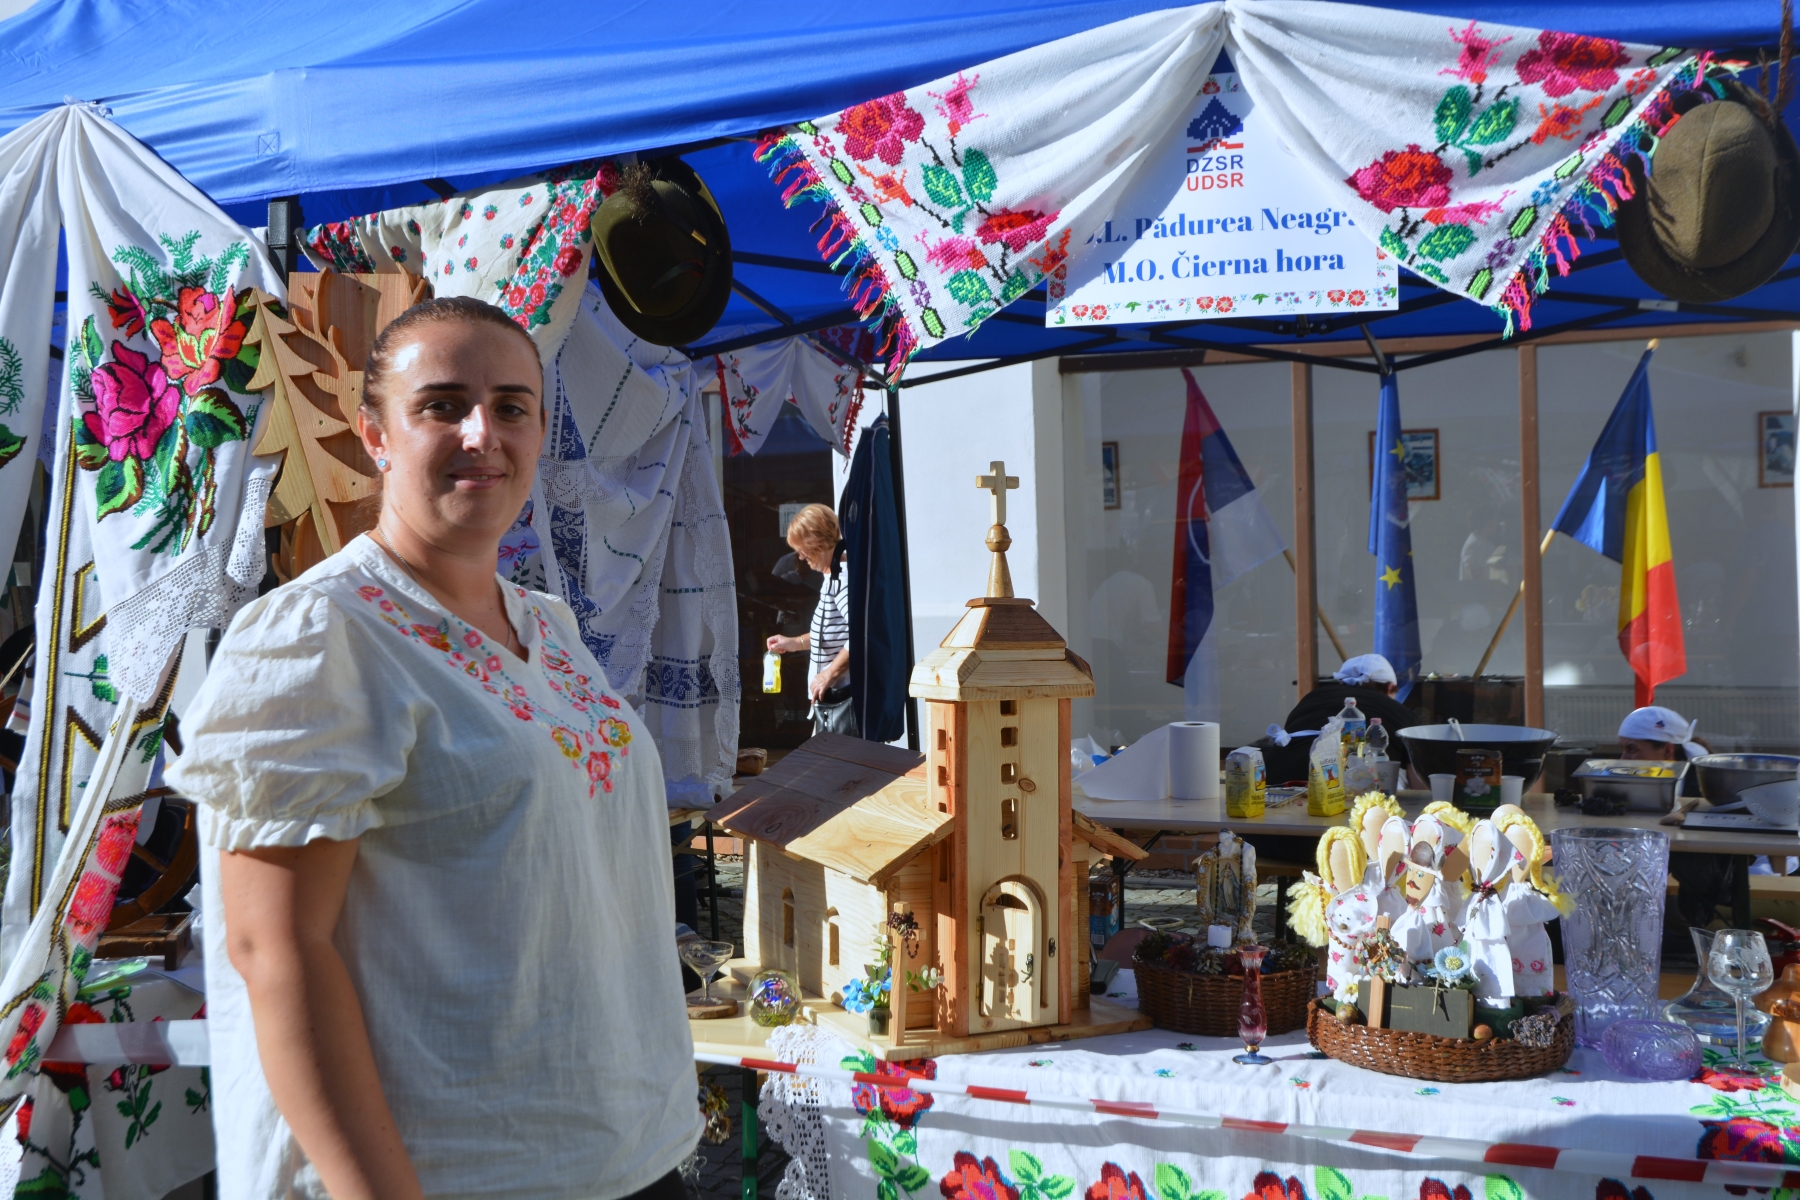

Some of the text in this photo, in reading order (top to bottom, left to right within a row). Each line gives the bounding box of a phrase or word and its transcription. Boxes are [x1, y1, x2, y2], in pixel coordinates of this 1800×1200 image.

[1187, 154, 1244, 174] DZSR
[1187, 172, 1244, 191] UDSR
[1084, 207, 1355, 245] .L. Pădurea Neagr
[1103, 248, 1346, 284] M.O. Čierna hora
